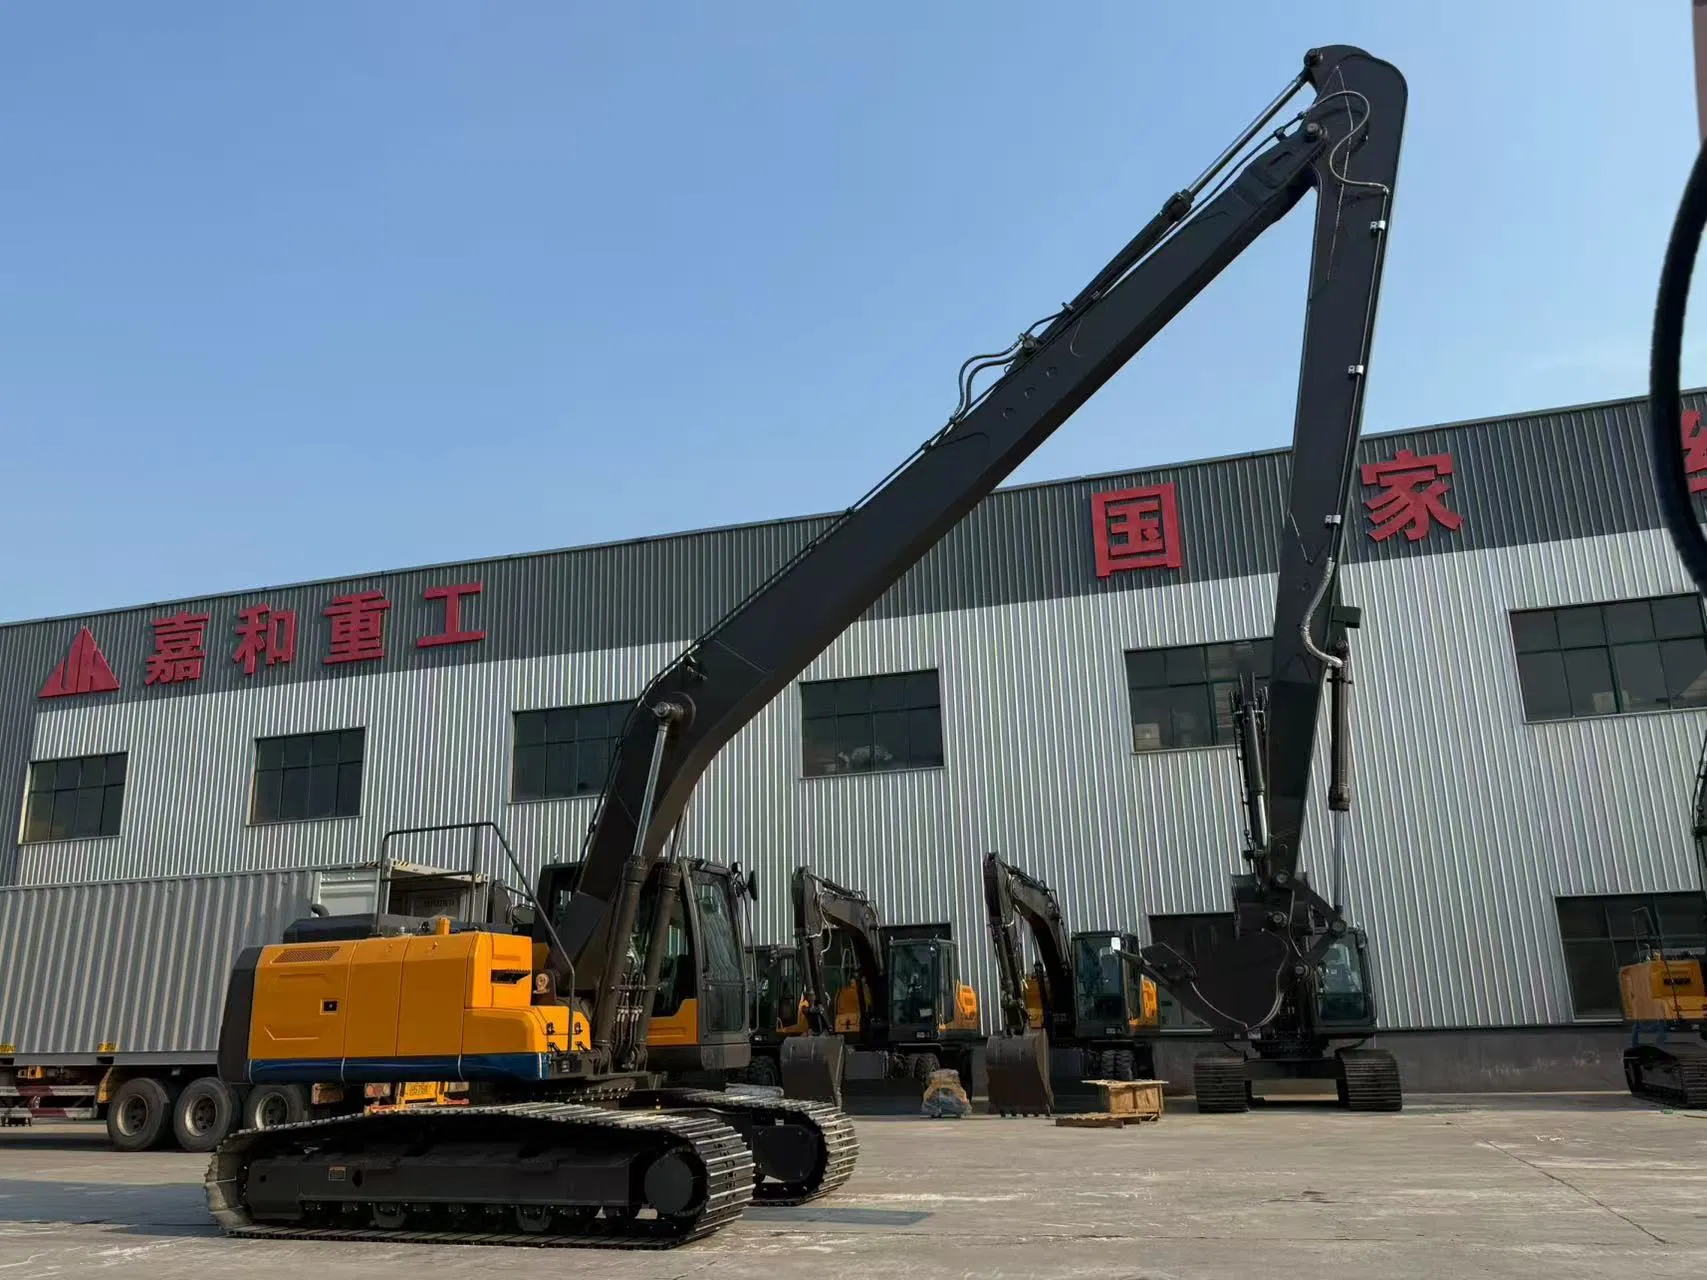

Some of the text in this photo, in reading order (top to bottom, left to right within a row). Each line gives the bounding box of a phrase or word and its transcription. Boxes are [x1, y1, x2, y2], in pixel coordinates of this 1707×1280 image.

[1091, 409, 1707, 577] 国家
[146, 583, 486, 685] 嘉和重工
